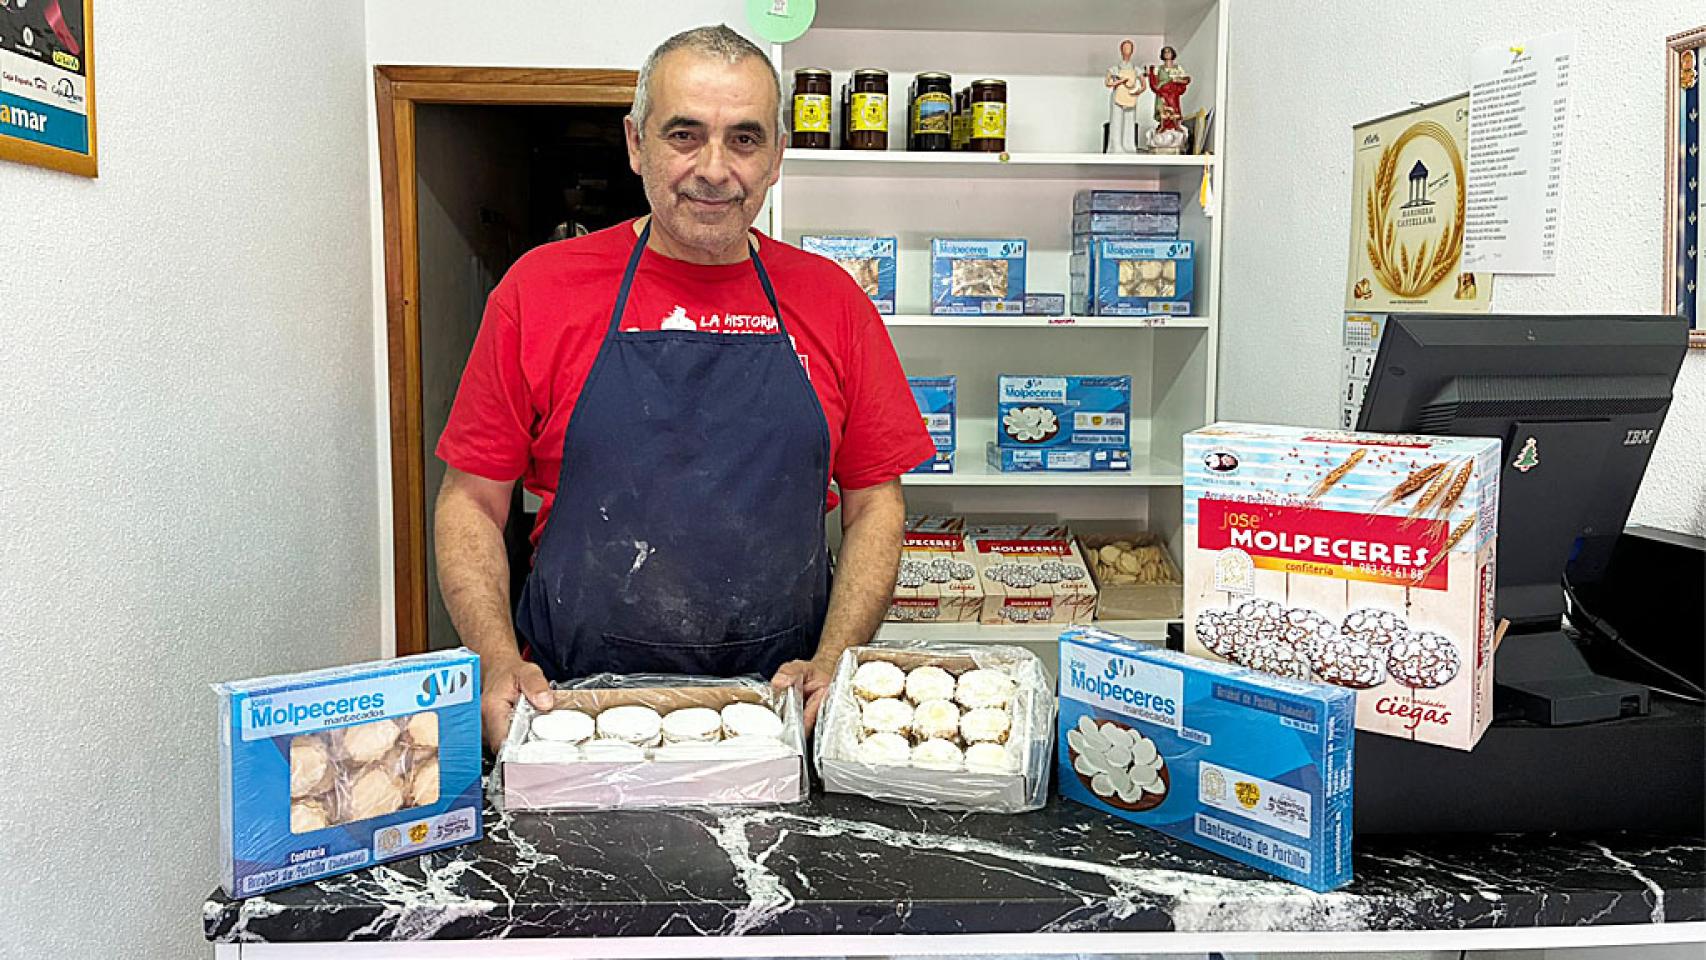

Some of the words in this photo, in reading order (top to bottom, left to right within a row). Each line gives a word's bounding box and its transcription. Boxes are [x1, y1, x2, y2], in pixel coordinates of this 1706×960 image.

[0, 104, 47, 132] amar
[700, 315, 720, 328] LA
[724, 313, 778, 331] HISTORIA
[1006, 387, 1062, 398] Molpeceres
[1624, 430, 1653, 445] IBM
[1230, 528, 1429, 567] MOLPECERES
[1380, 565, 1392, 577] 55
[1395, 567, 1406, 578] 61
[1071, 669, 1175, 715] Molpeceres
[251, 692, 384, 728] Molpeceres
[324, 710, 385, 726] mantecados
[1123, 705, 1175, 725] mantecados
[1376, 697, 1451, 730] Ciegas
[1200, 817, 1252, 850] Mantecados
[1257, 839, 1269, 856] de
[1272, 844, 1305, 869] Portillo
